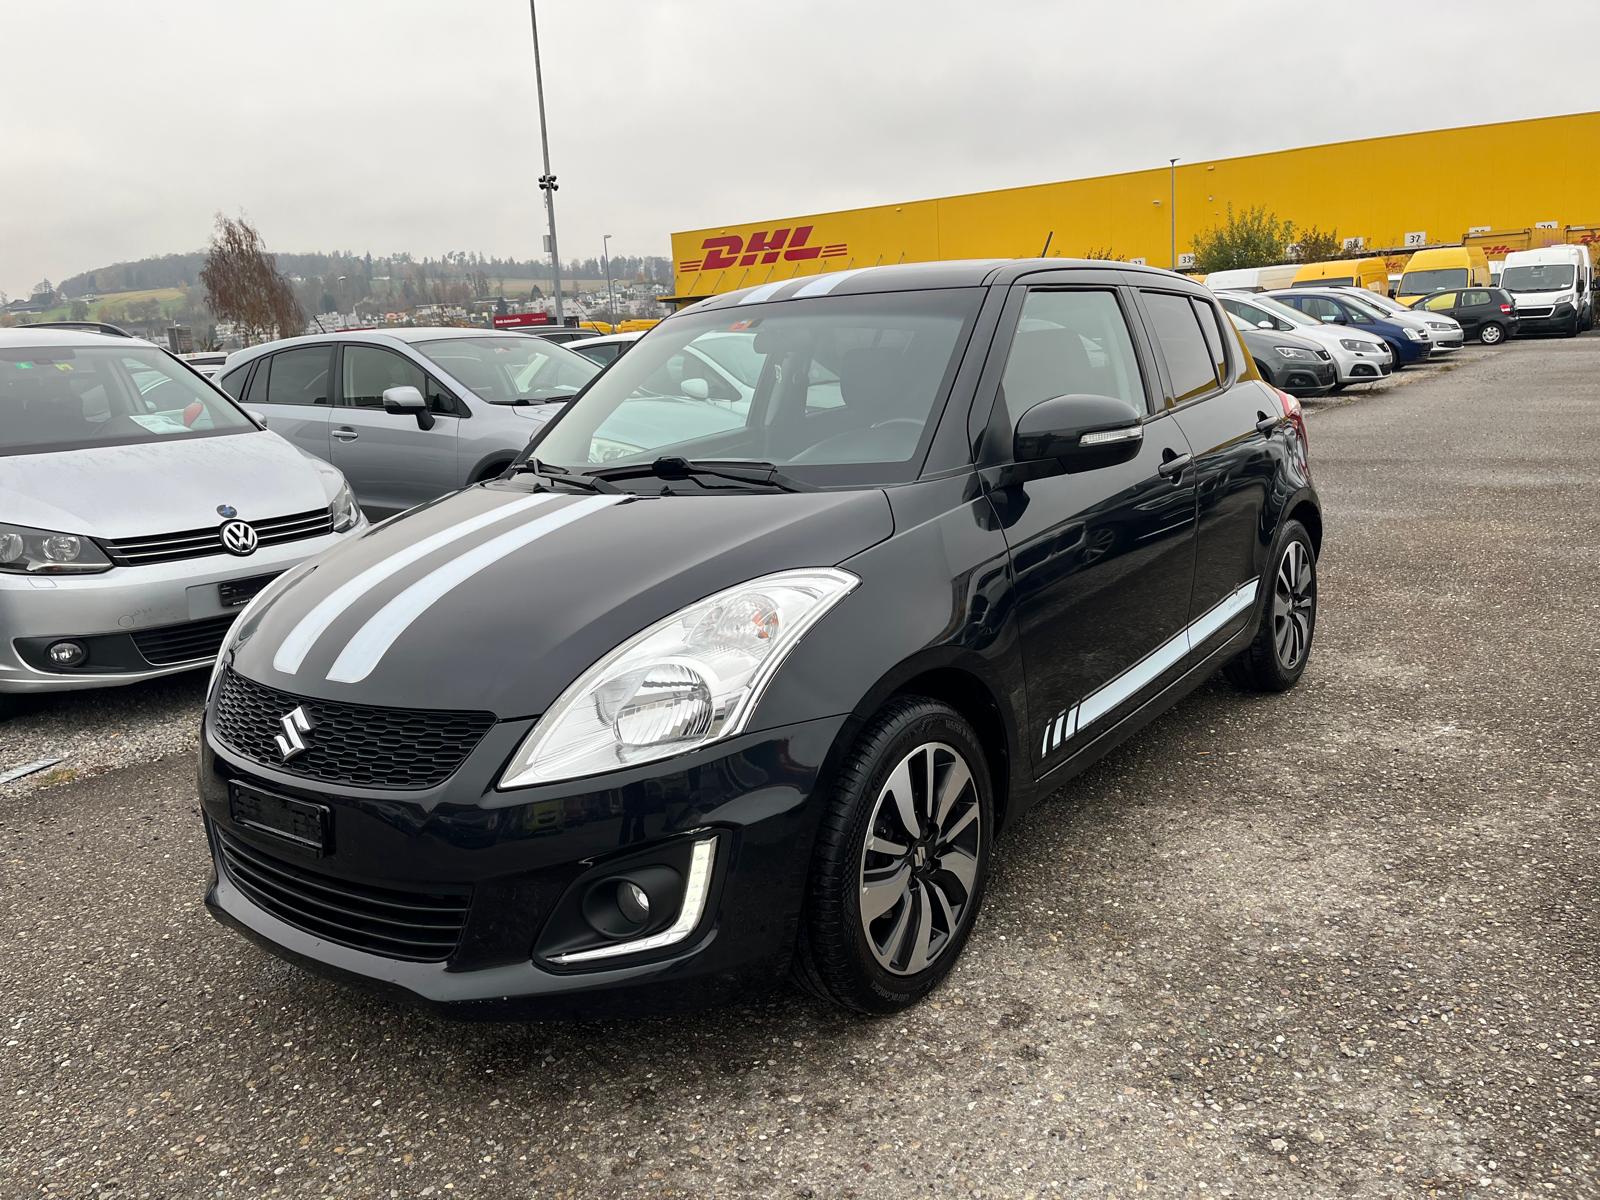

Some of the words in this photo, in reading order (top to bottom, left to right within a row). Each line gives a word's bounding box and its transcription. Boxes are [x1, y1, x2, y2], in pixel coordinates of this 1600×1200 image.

[1409, 234, 1421, 243] 37
[701, 225, 823, 270] DHL
[1182, 255, 1191, 264] 33
